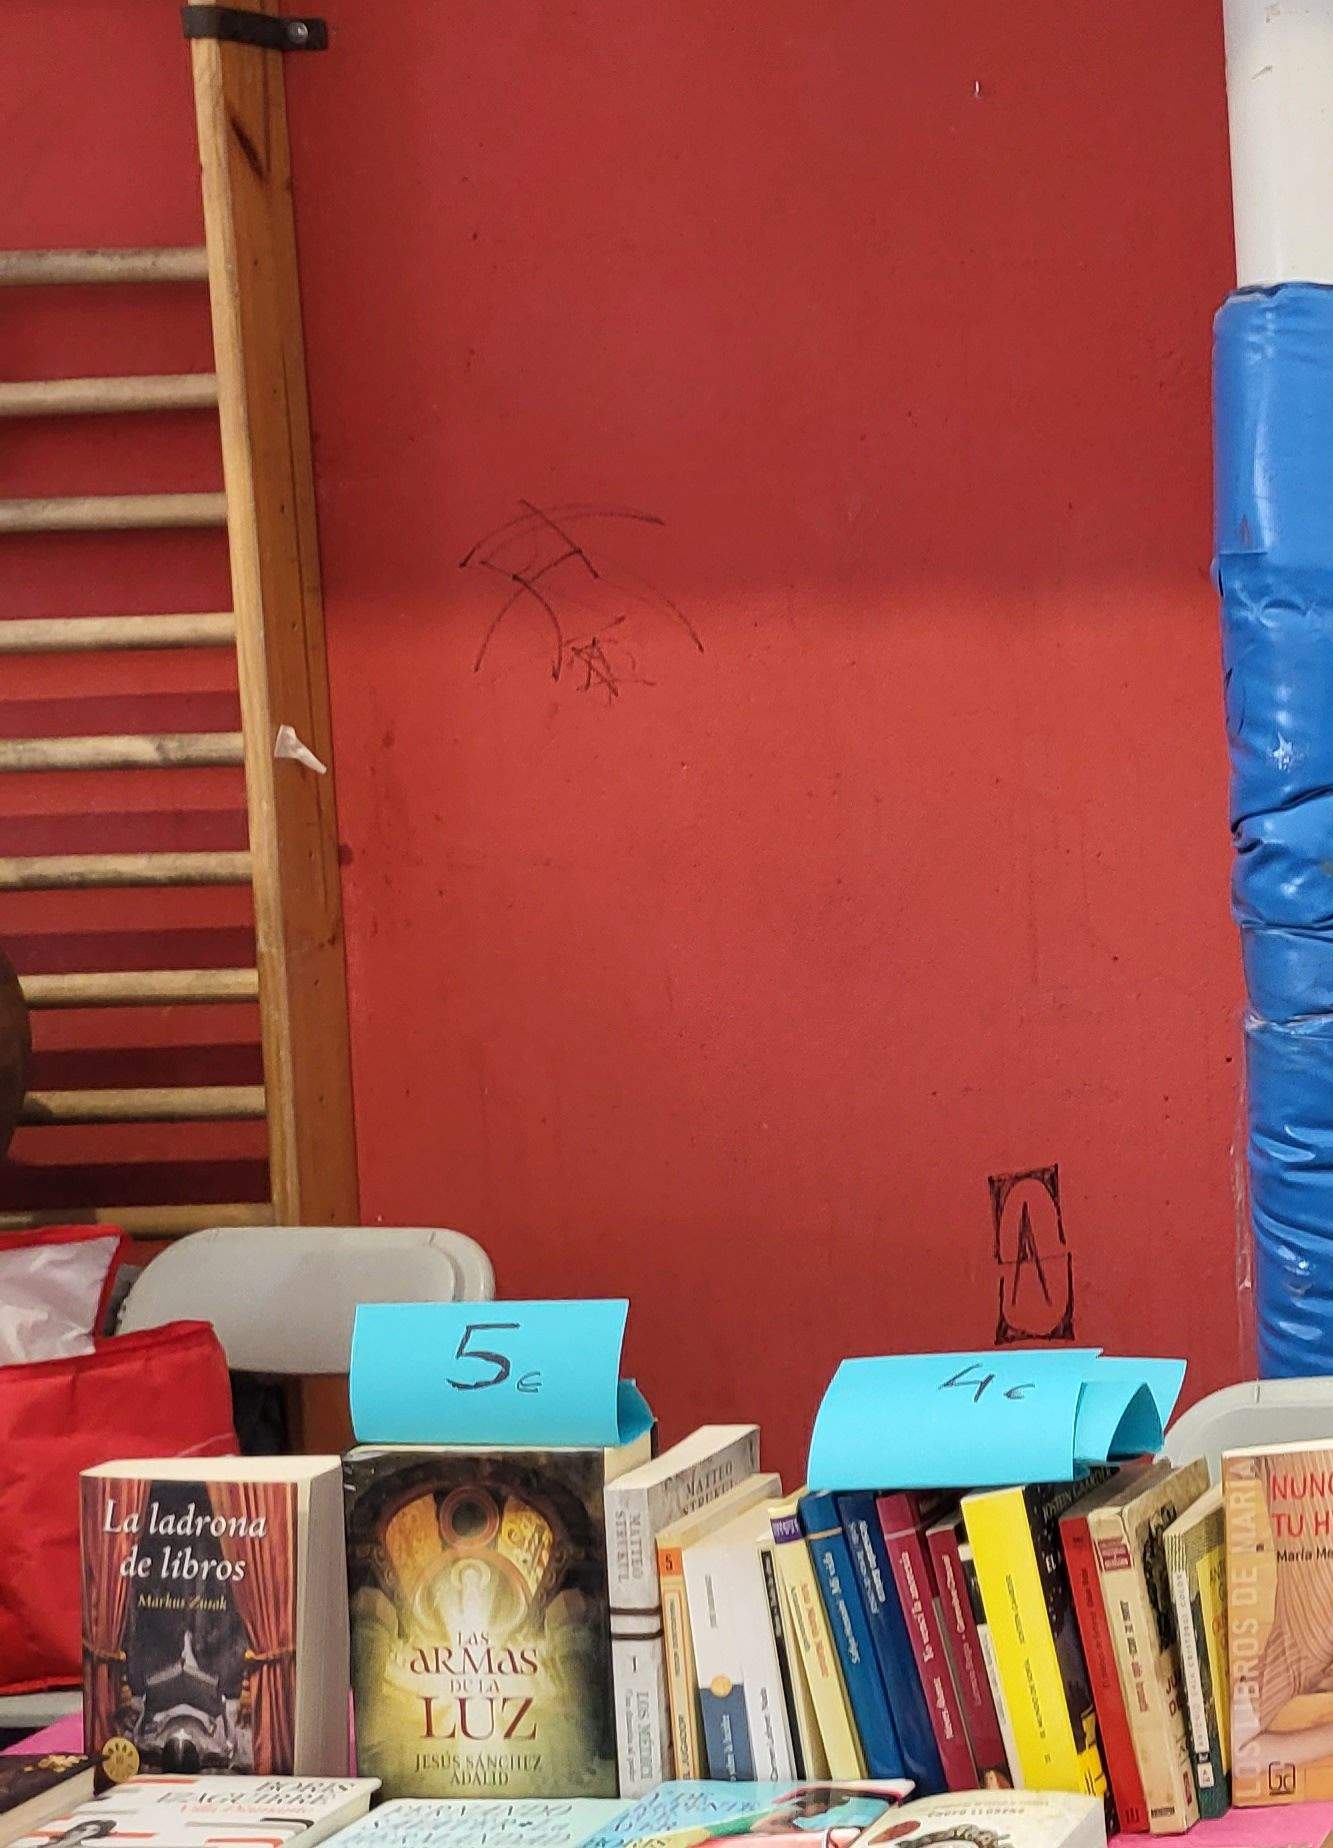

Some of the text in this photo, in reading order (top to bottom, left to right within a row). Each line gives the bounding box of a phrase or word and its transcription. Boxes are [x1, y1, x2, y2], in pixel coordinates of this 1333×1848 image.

[103, 1498, 267, 1538] La ladrona
[1272, 1513, 1305, 1538] TU
[119, 1544, 246, 1582] de libros
[1276, 1548, 1313, 1563] María
[1230, 1566, 1259, 1609] DE
[417, 1695, 537, 1741] LUZ
